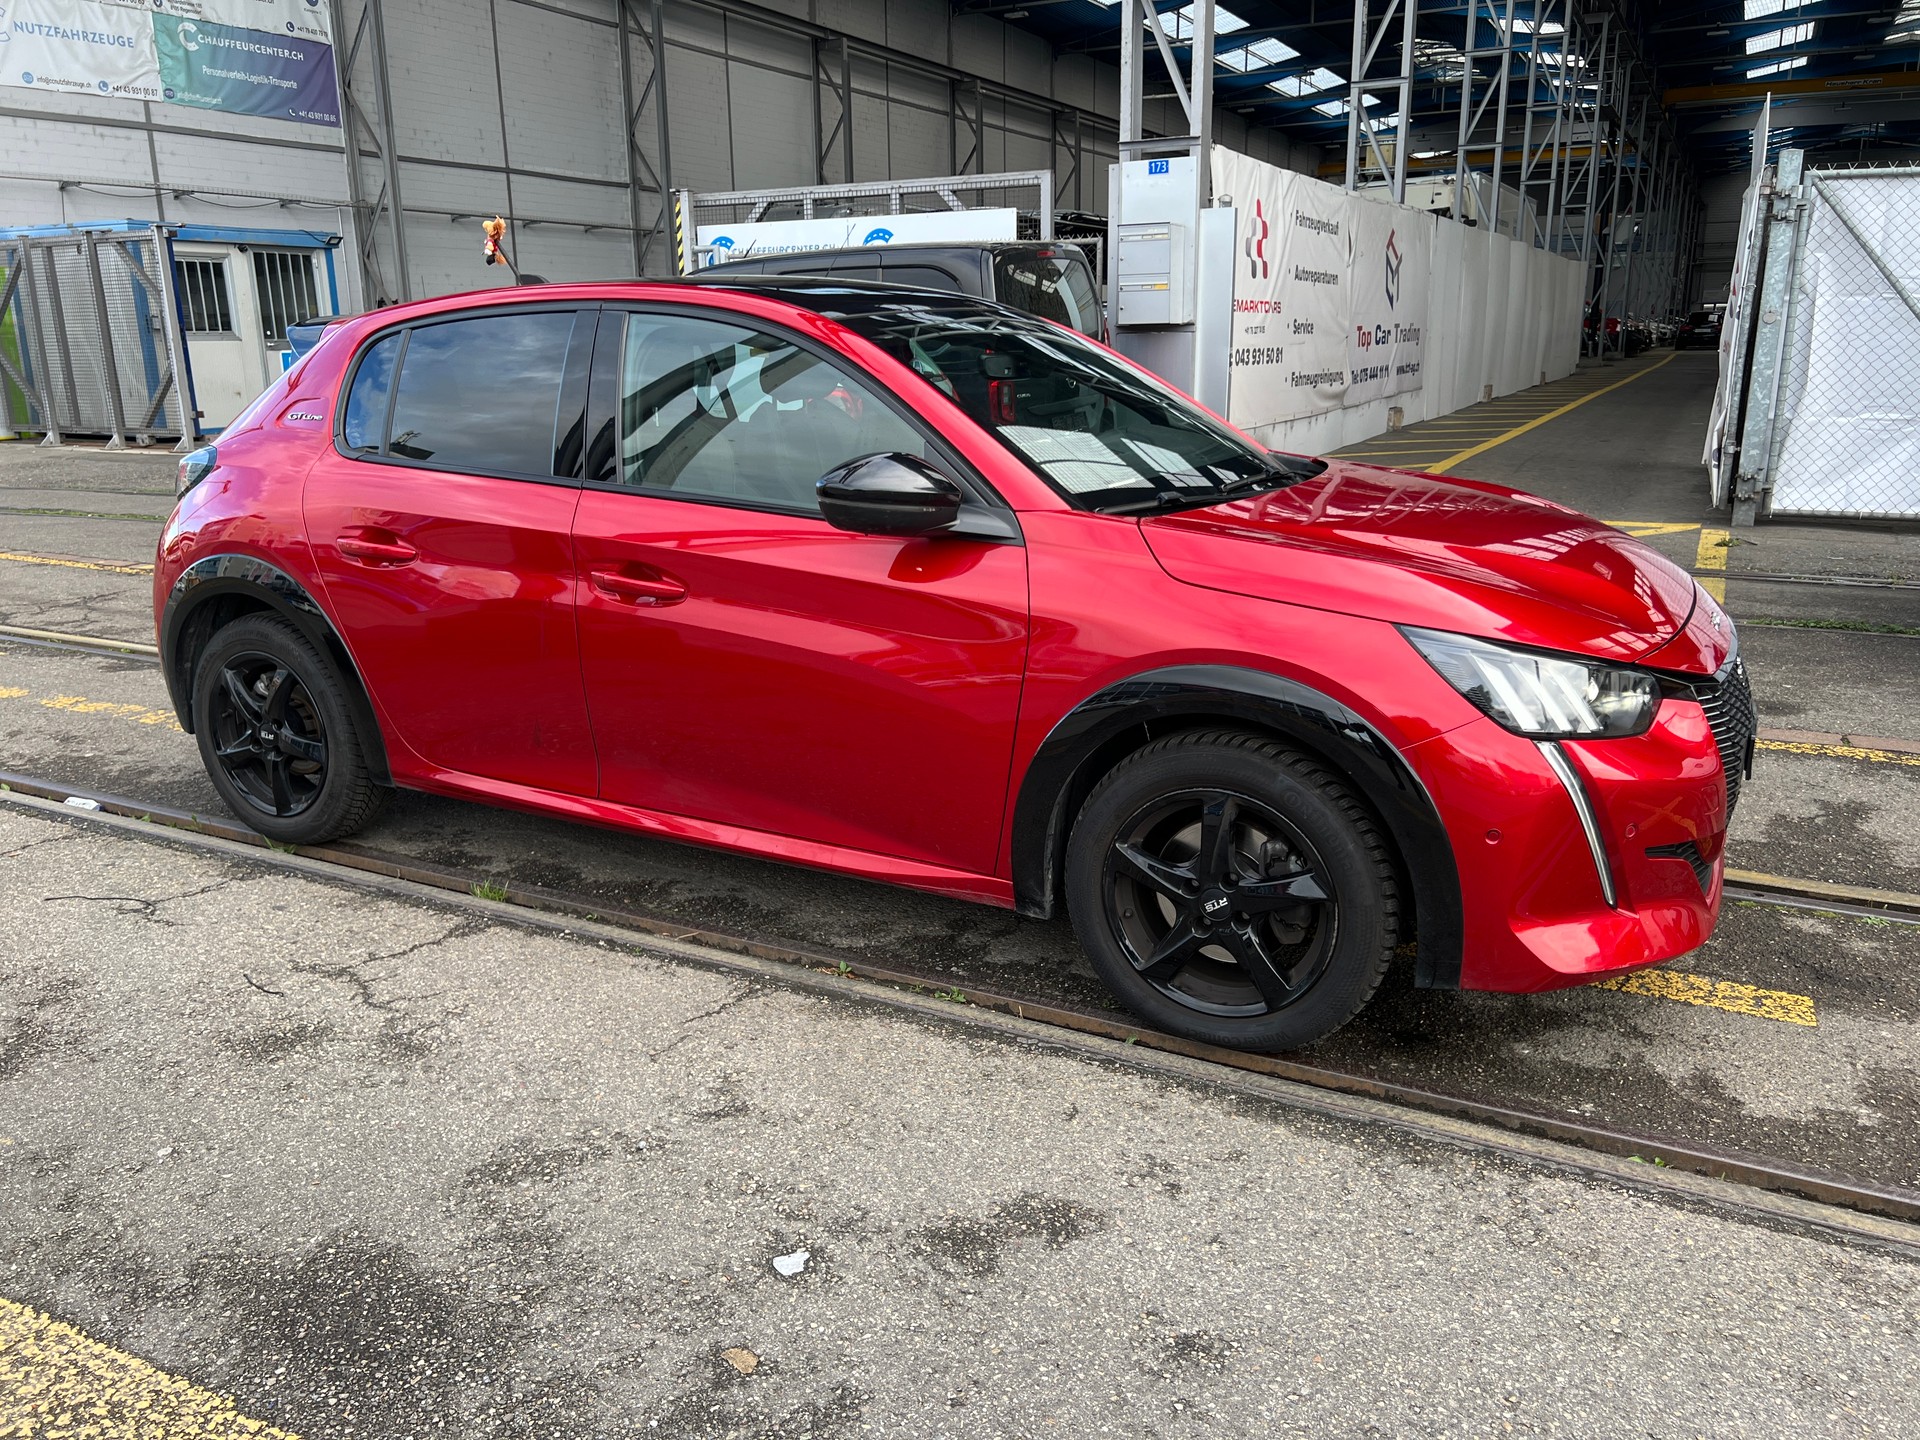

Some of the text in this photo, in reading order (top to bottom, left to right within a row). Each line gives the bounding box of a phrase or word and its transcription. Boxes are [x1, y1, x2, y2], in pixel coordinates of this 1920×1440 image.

[13, 20, 134, 48] NUTZFAHRZEUGE
[198, 34, 304, 62] CHAUFFEURCENTER.CH
[202, 65, 298, 90] Personalverleih-Logistik-Transporte
[1150, 161, 1167, 173] 173
[1295, 210, 1339, 236] Fahrzeugverkauf
[1294, 265, 1339, 286] Autoreparaturen
[1293, 318, 1314, 334] Service
[1357, 322, 1420, 352] Top Car Trading
[1235, 348, 1250, 366] 043
[1252, 348, 1265, 365] 931
[1266, 347, 1274, 364] 50
[1276, 347, 1283, 363] 81
[1369, 366, 1378, 381] 444
[1204, 897, 1228, 913] RTS
